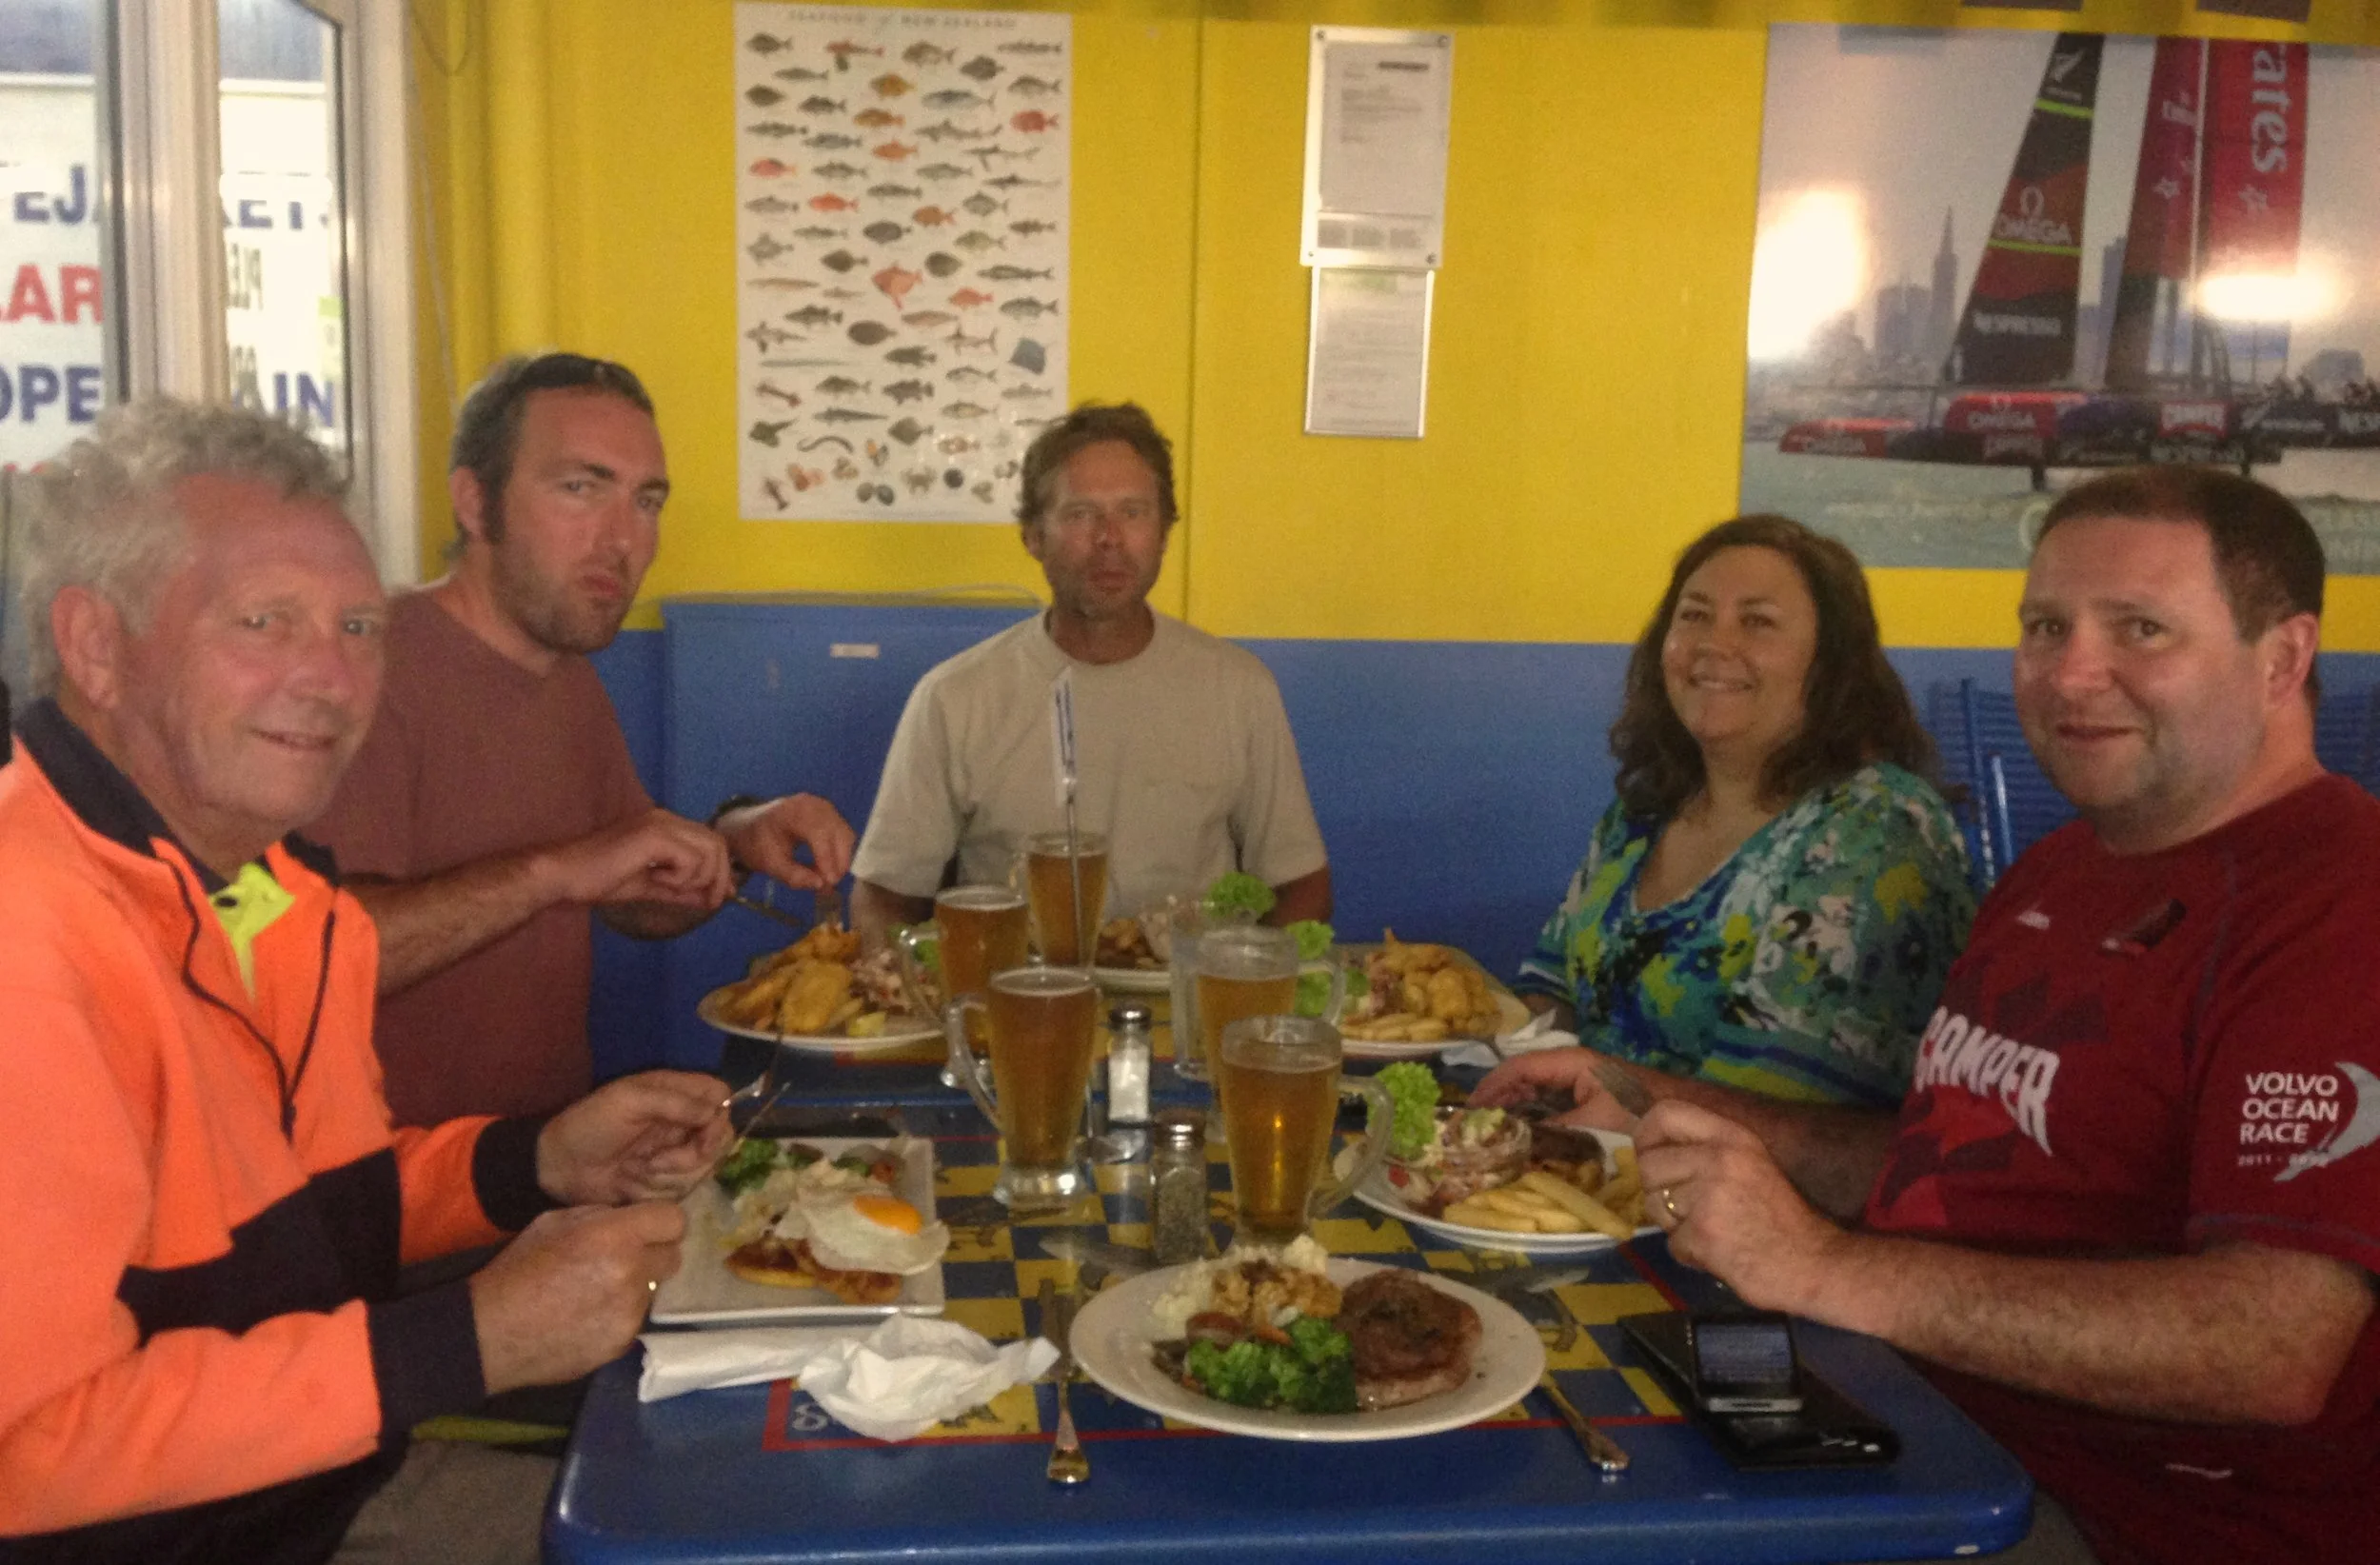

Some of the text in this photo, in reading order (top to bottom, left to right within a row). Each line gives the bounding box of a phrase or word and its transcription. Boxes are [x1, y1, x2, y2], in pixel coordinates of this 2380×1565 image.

[2251, 42, 2292, 173] ates
[0, 263, 103, 324] AR
[1914, 1005, 2061, 1158] CAMPER
[2245, 1072, 2339, 1097] VOLVO
[2242, 1098, 2340, 1122] OCEAN
[2239, 1121, 2311, 1145] RACE
